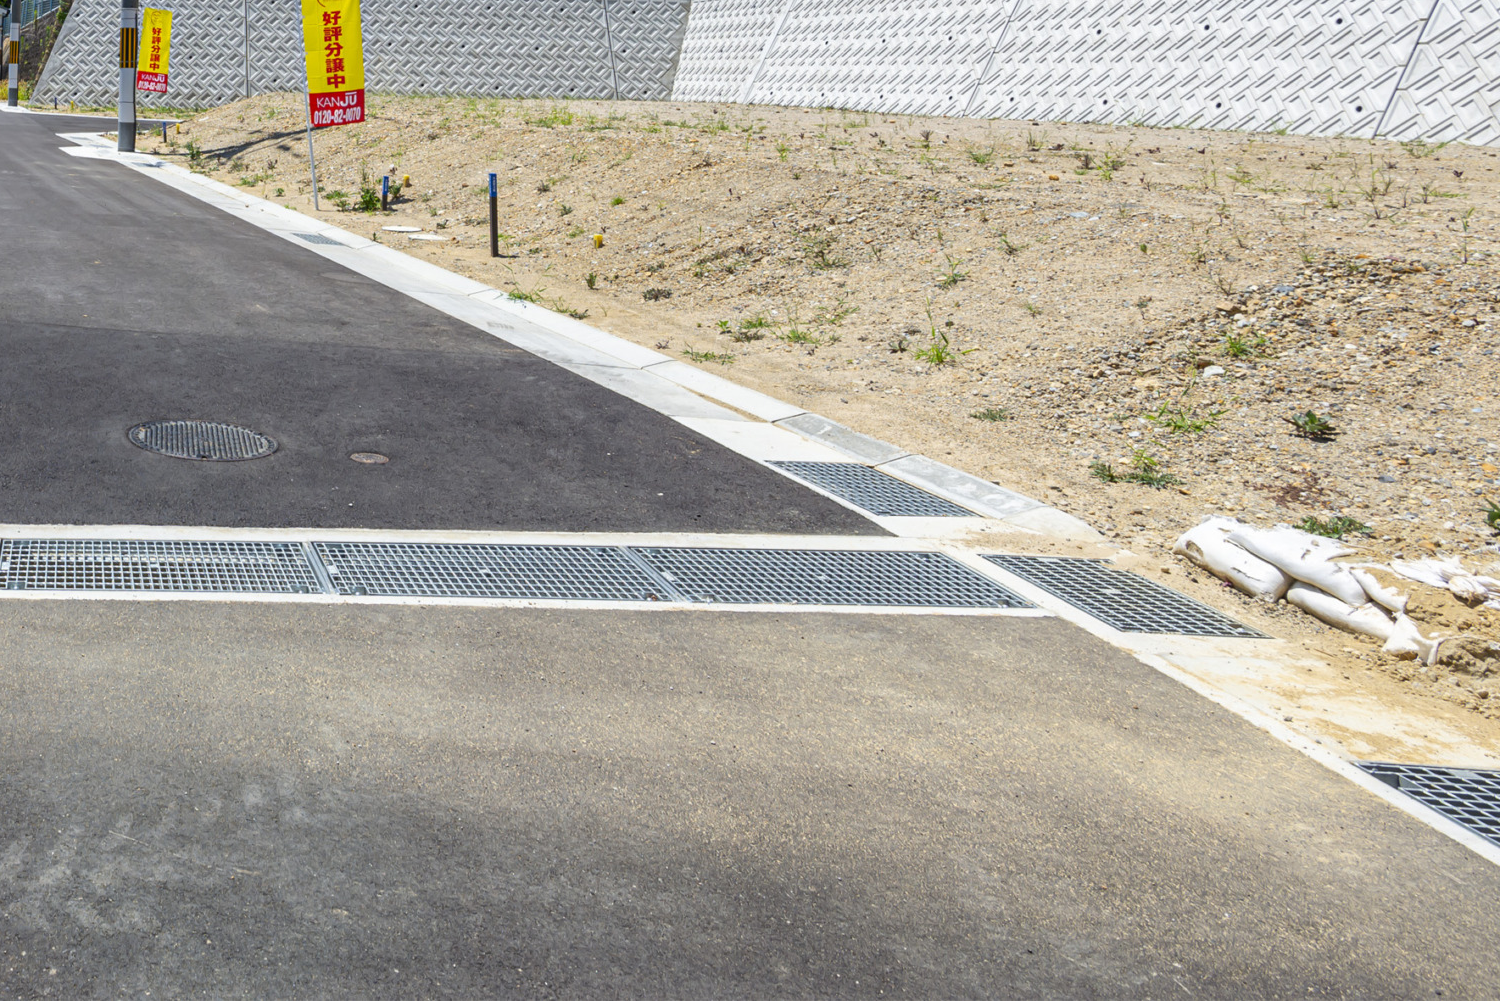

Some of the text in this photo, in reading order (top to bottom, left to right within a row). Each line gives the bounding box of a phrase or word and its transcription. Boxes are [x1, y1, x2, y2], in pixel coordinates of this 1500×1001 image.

[322, 11, 346, 89] 好評分譲中
[313, 106, 361, 125] 0120-82-0070
